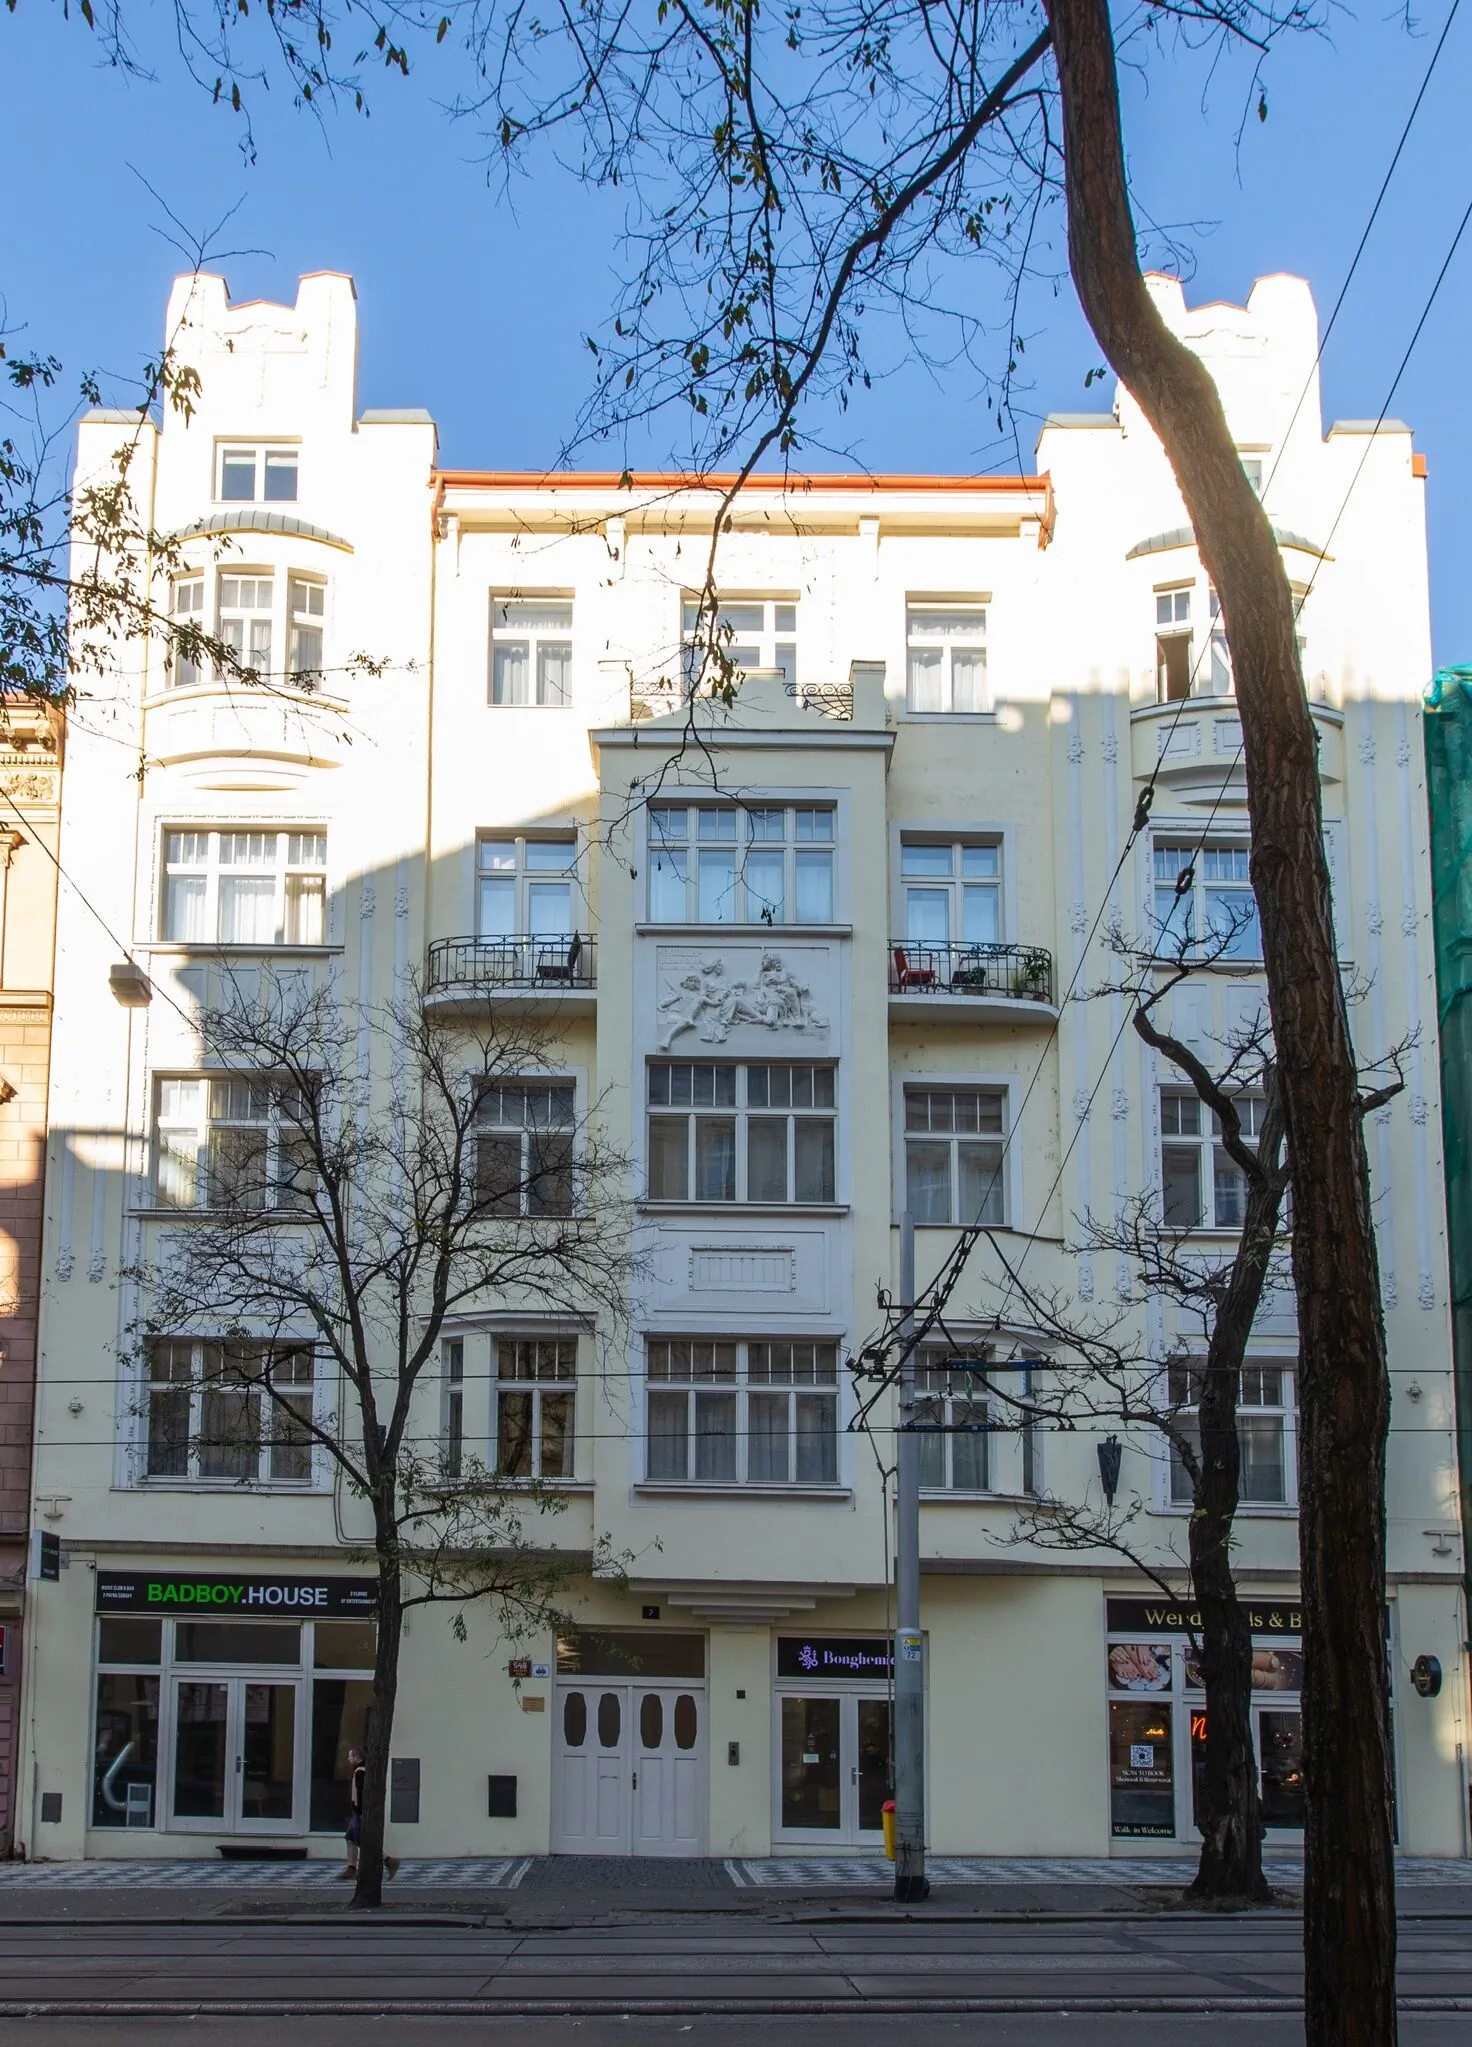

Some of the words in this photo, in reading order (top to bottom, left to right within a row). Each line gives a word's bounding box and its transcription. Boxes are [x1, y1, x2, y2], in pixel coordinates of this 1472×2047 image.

[148, 1583, 328, 1606] BADBOY.HOUSE
[1268, 1612, 1285, 1628] &
[906, 1651, 916, 1660] 72
[1141, 1826, 1173, 1835] Welcome
